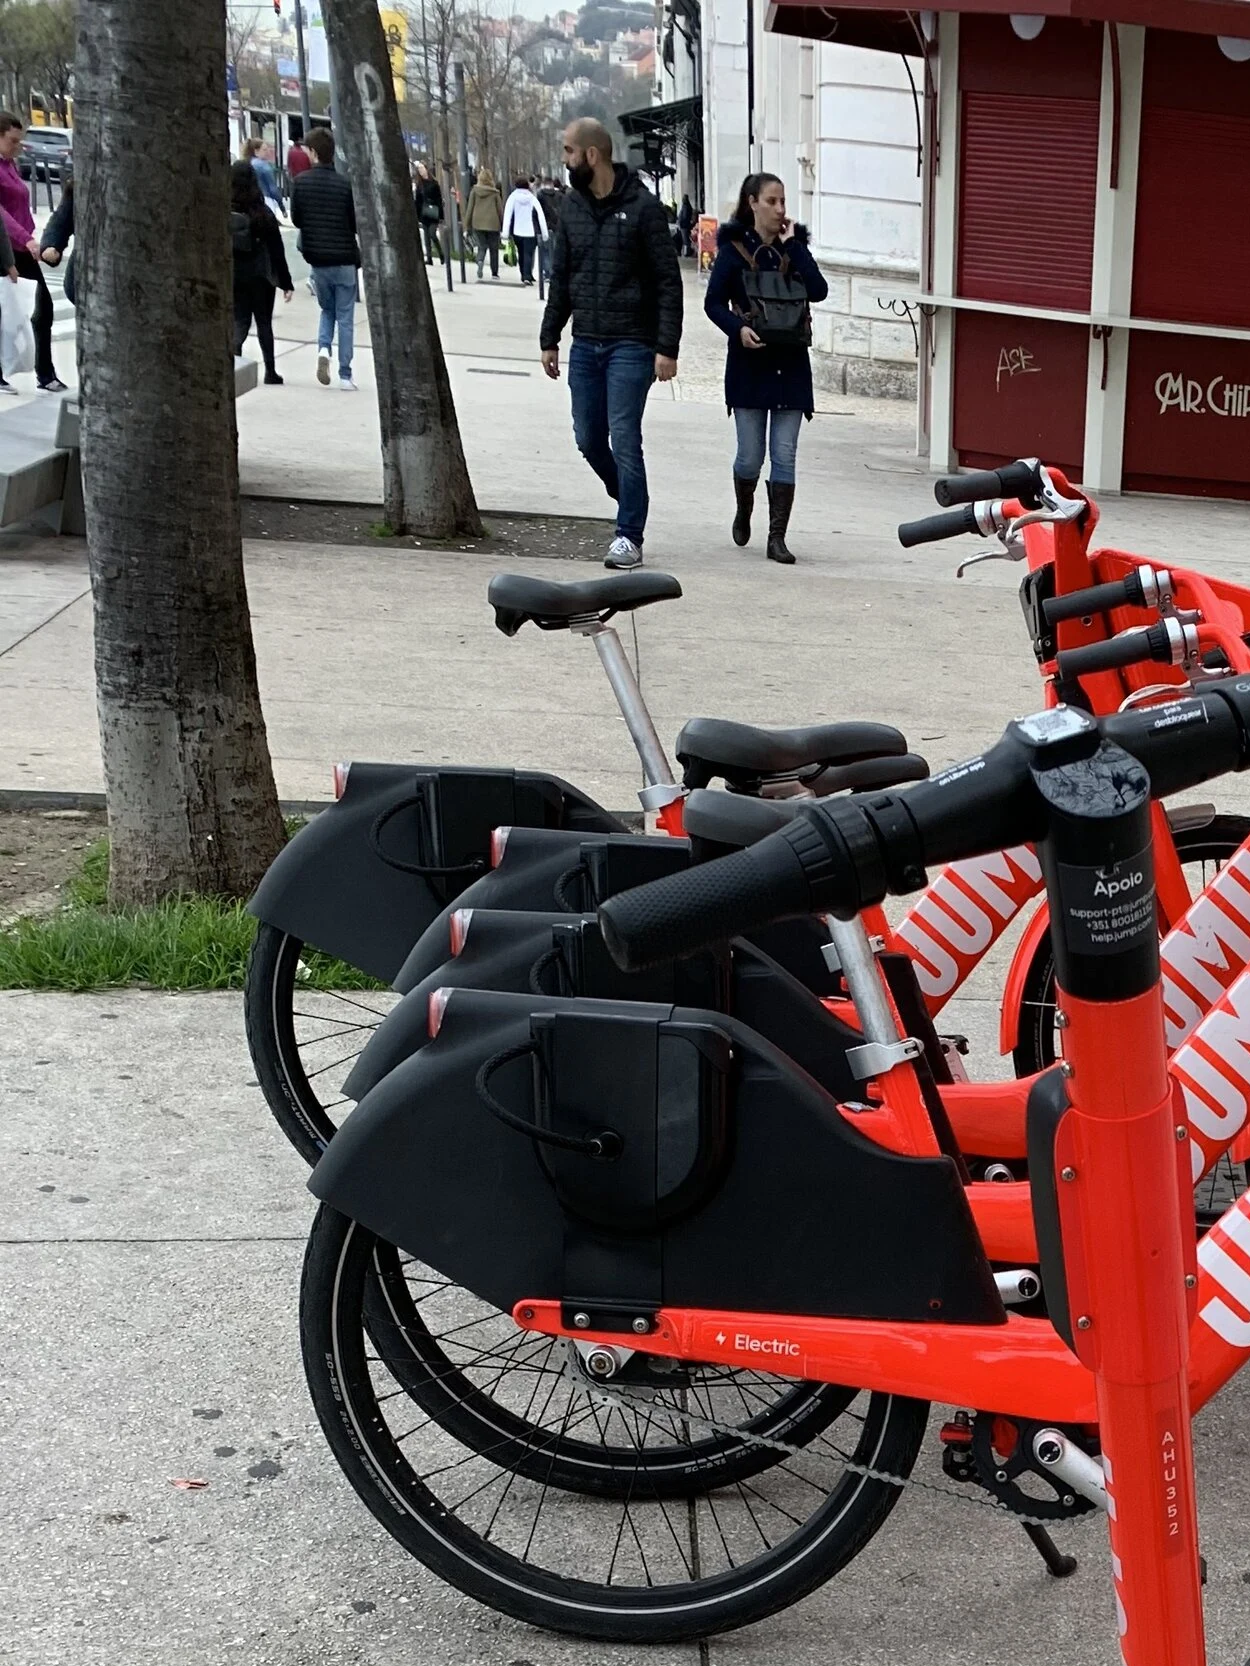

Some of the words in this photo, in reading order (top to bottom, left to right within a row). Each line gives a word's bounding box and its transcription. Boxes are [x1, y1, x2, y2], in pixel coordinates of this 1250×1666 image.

[1094, 872, 1143, 898] Apoio
[896, 845, 1043, 996] JUM
[1087, 920, 1110, 931] +351
[734, 1333, 801, 1356] Electric
